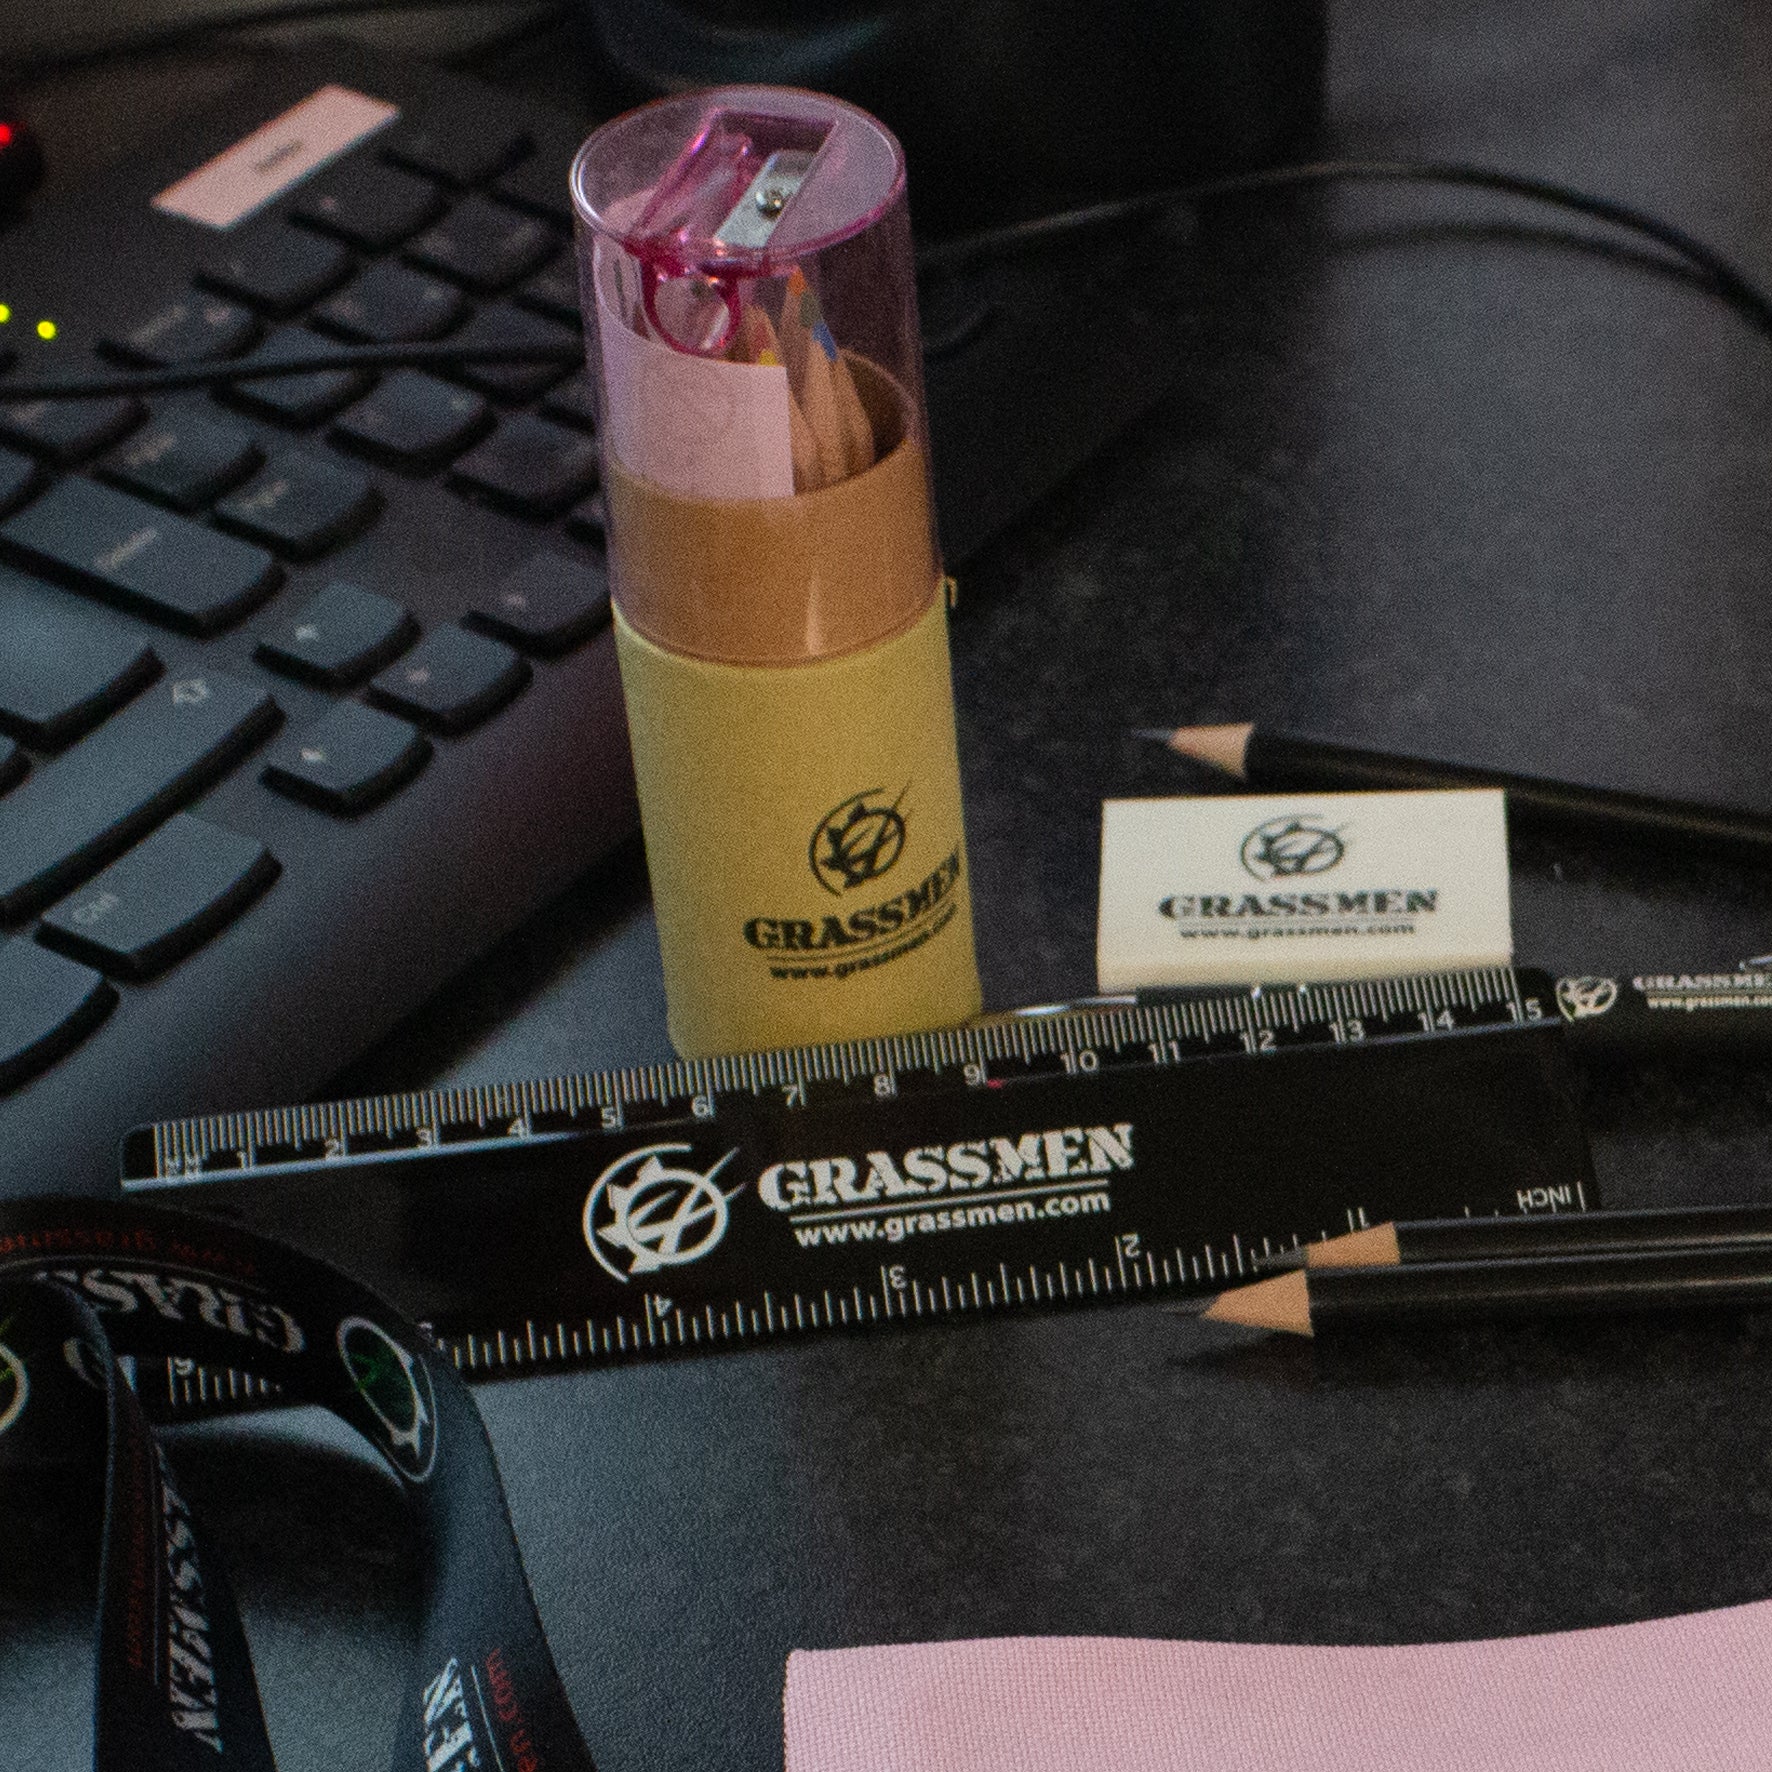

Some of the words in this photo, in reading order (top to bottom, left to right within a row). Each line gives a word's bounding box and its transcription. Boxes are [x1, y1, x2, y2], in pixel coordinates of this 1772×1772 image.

[1158, 889, 1440, 920] GRASSMEN
[1179, 921, 1416, 941] www.grassmen.com
[415, 1129, 432, 1149] 3
[507, 1119, 525, 1138] 4
[601, 1109, 617, 1128] 5
[691, 1096, 708, 1118] 6
[783, 1086, 799, 1107] 7
[874, 1075, 890, 1097] 8
[964, 1065, 981, 1086] 9
[1060, 1051, 1098, 1075] 10
[1149, 1041, 1181, 1064] 11
[1240, 1030, 1277, 1054] 12
[1331, 1020, 1365, 1043] 13
[1418, 1010, 1455, 1033] 14
[1506, 999, 1542, 1022] 15
[758, 1122, 1135, 1211] GRASSMEN
[794, 1190, 1111, 1248] www.grassmen.com
[1122, 1233, 1141, 1257] 2
[888, 1265, 907, 1289] 3
[654, 1294, 673, 1318] 4
